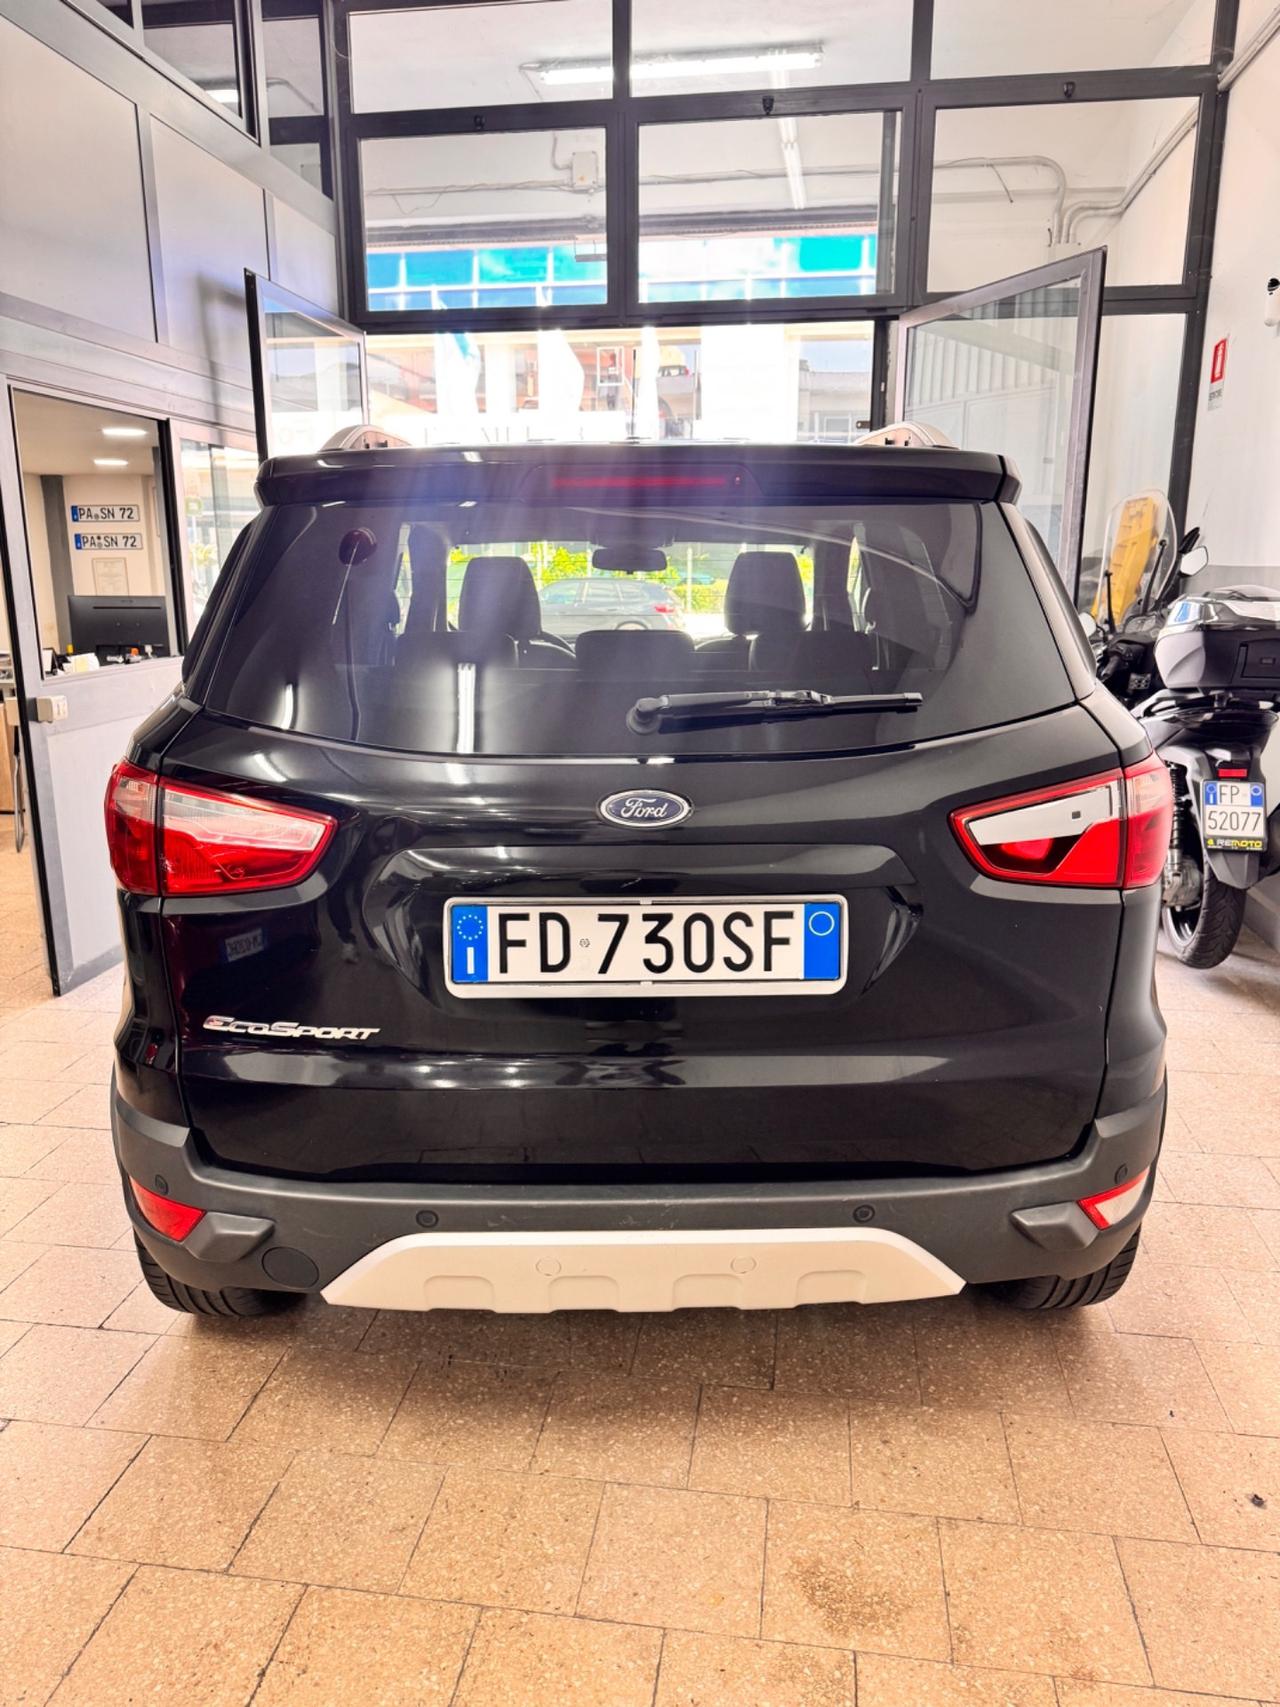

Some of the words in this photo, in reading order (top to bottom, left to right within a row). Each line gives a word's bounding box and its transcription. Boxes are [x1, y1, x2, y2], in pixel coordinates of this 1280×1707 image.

[78, 507, 93, 520] PA
[100, 507, 115, 520] SN
[119, 507, 134, 520] 72
[82, 535, 96, 547] PA
[103, 535, 118, 547] SN
[122, 535, 137, 547] 72
[1219, 784, 1240, 804] FP
[620, 797, 668, 818] Ford
[1208, 810, 1261, 832] 52077
[497, 911, 572, 975] FD
[596, 910, 795, 975] 730SF
